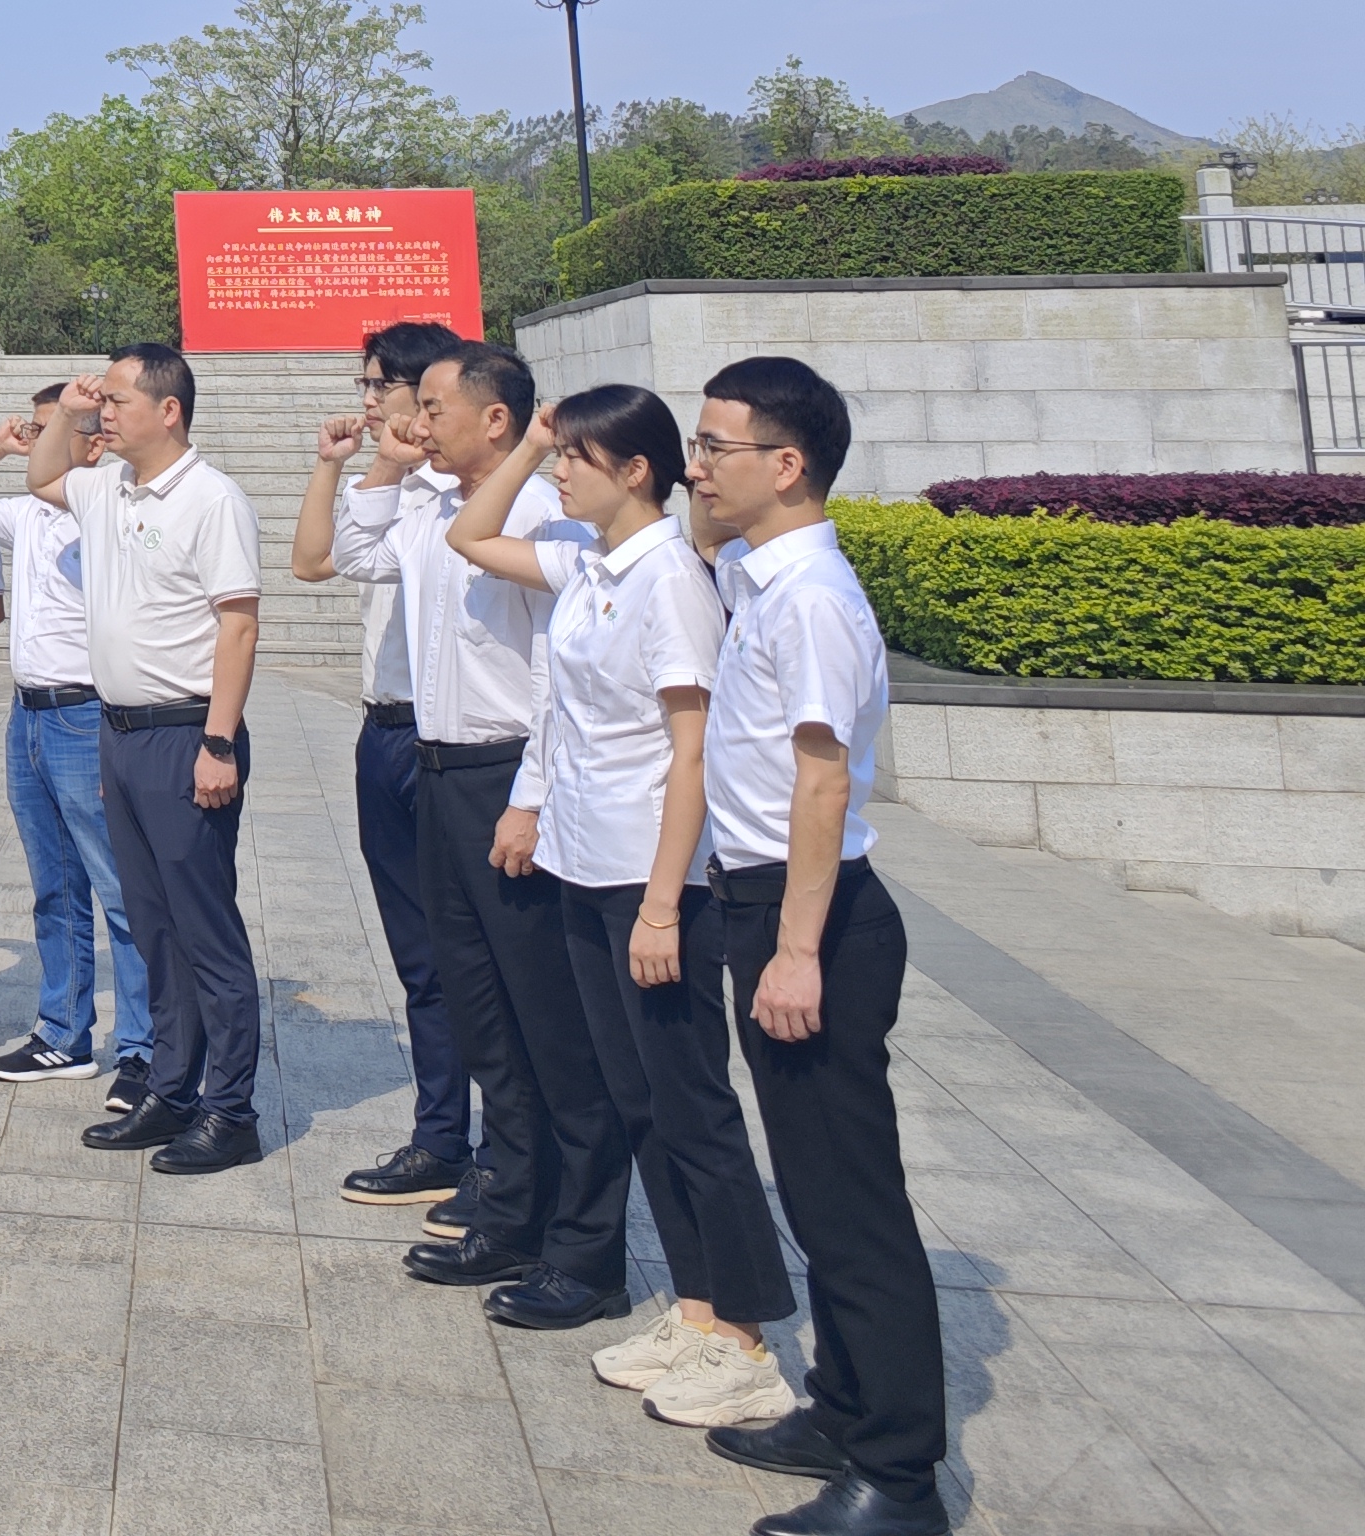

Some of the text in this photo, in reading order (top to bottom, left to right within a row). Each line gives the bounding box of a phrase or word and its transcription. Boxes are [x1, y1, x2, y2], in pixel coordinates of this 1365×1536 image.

[268, 206, 382, 223] 伟大抗战精神
